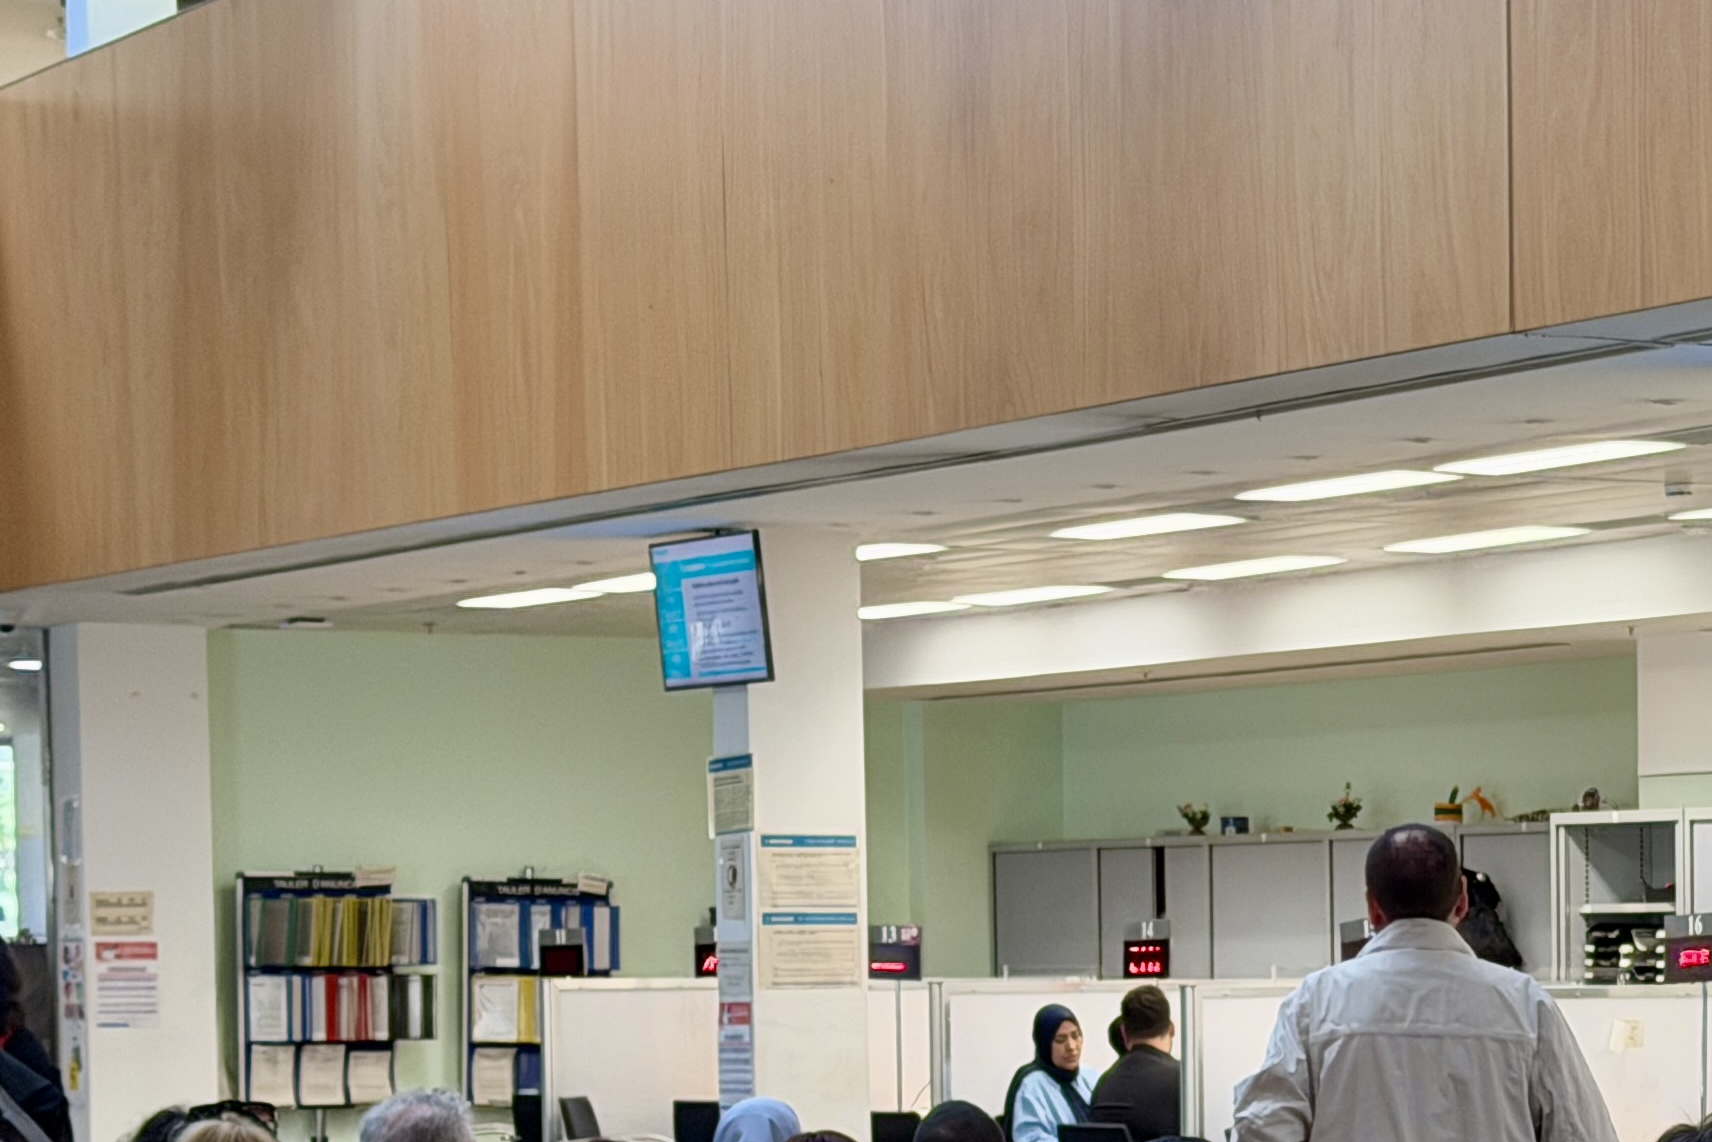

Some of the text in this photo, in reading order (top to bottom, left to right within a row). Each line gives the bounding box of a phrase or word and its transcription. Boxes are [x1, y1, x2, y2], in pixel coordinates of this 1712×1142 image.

[881, 925, 897, 944] 13
[1141, 920, 1154, 939] 14
[1688, 914, 1703, 937] 16
